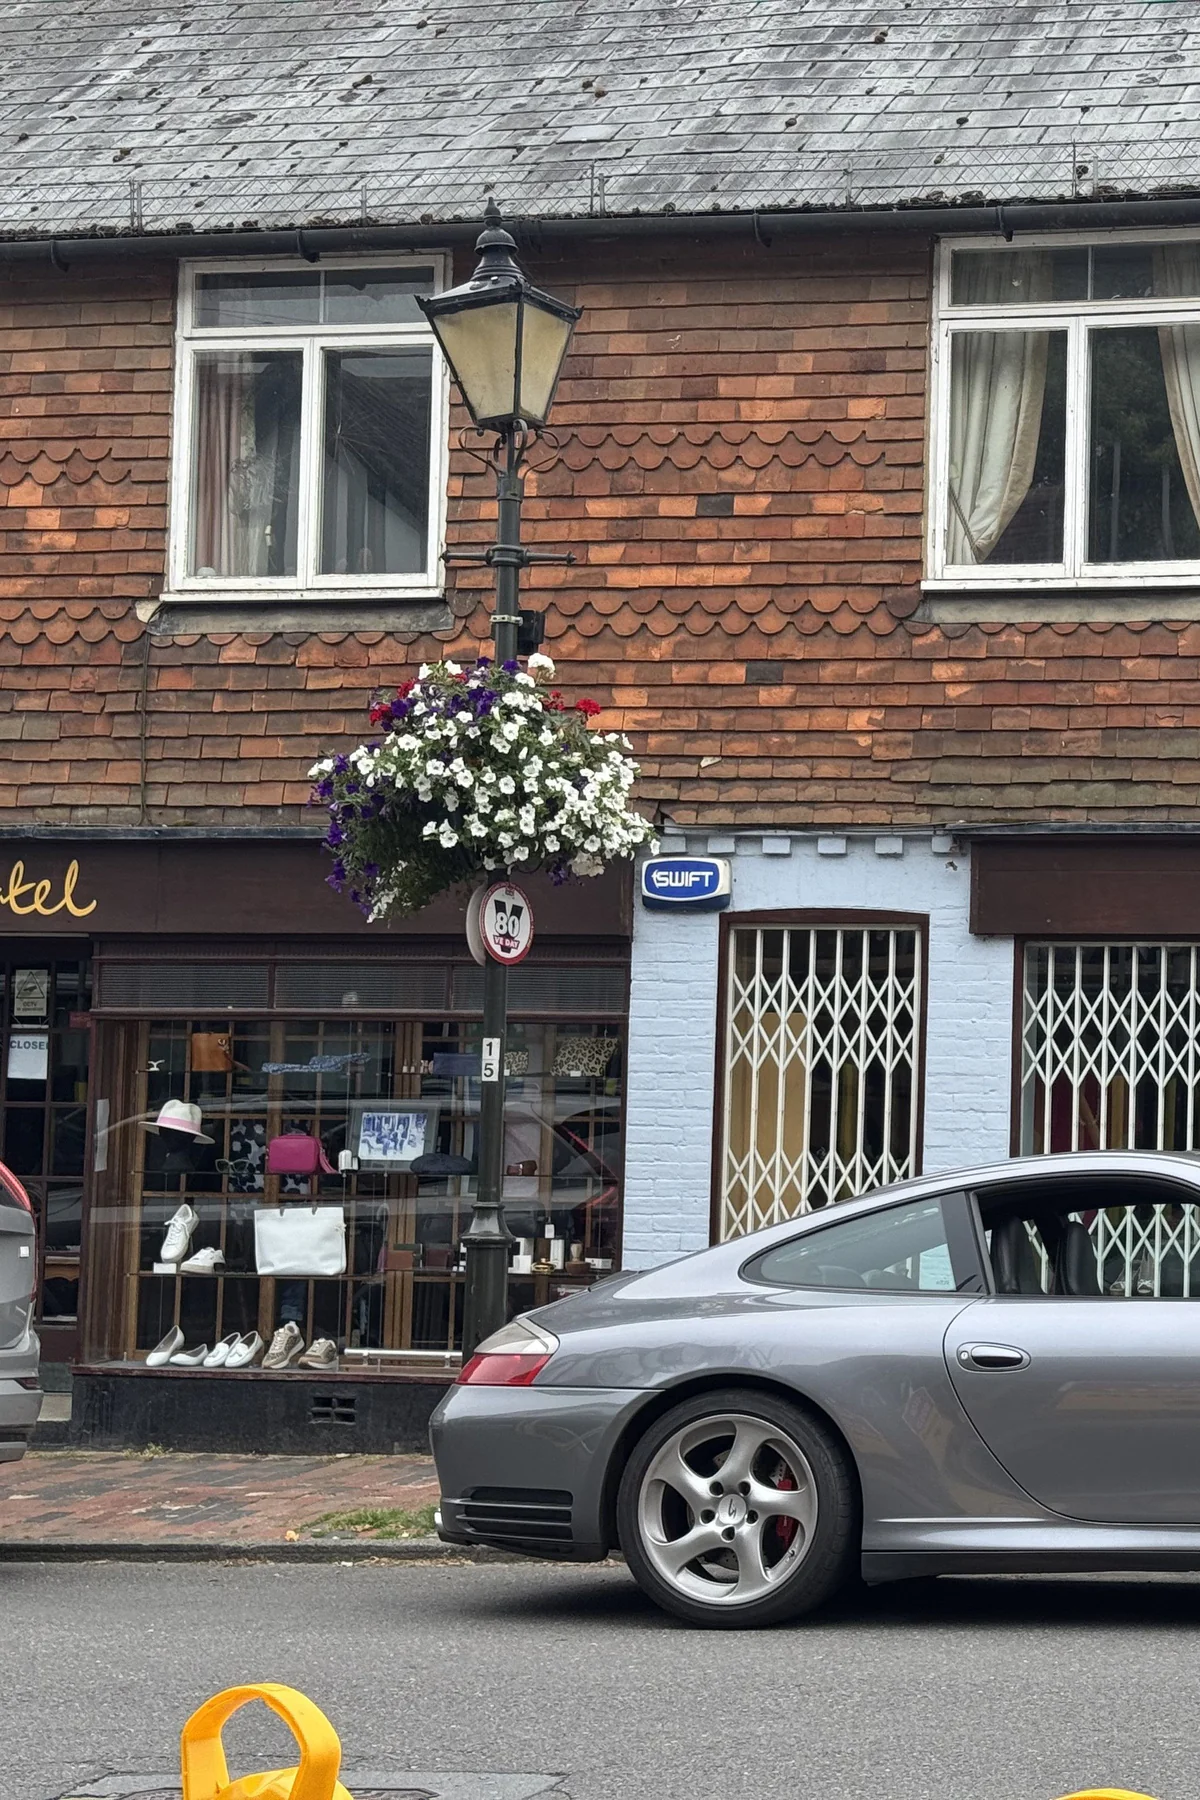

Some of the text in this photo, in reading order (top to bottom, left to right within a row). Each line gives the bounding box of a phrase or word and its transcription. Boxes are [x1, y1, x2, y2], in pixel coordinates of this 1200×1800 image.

[651, 869, 714, 889] SWIFT
[495, 911, 520, 938] 80
[494, 936, 519, 949] VE DAY
[10, 1040, 48, 1050] CLOSE
[486, 1041, 493, 1057] 1
[484, 1063, 494, 1078] 5
